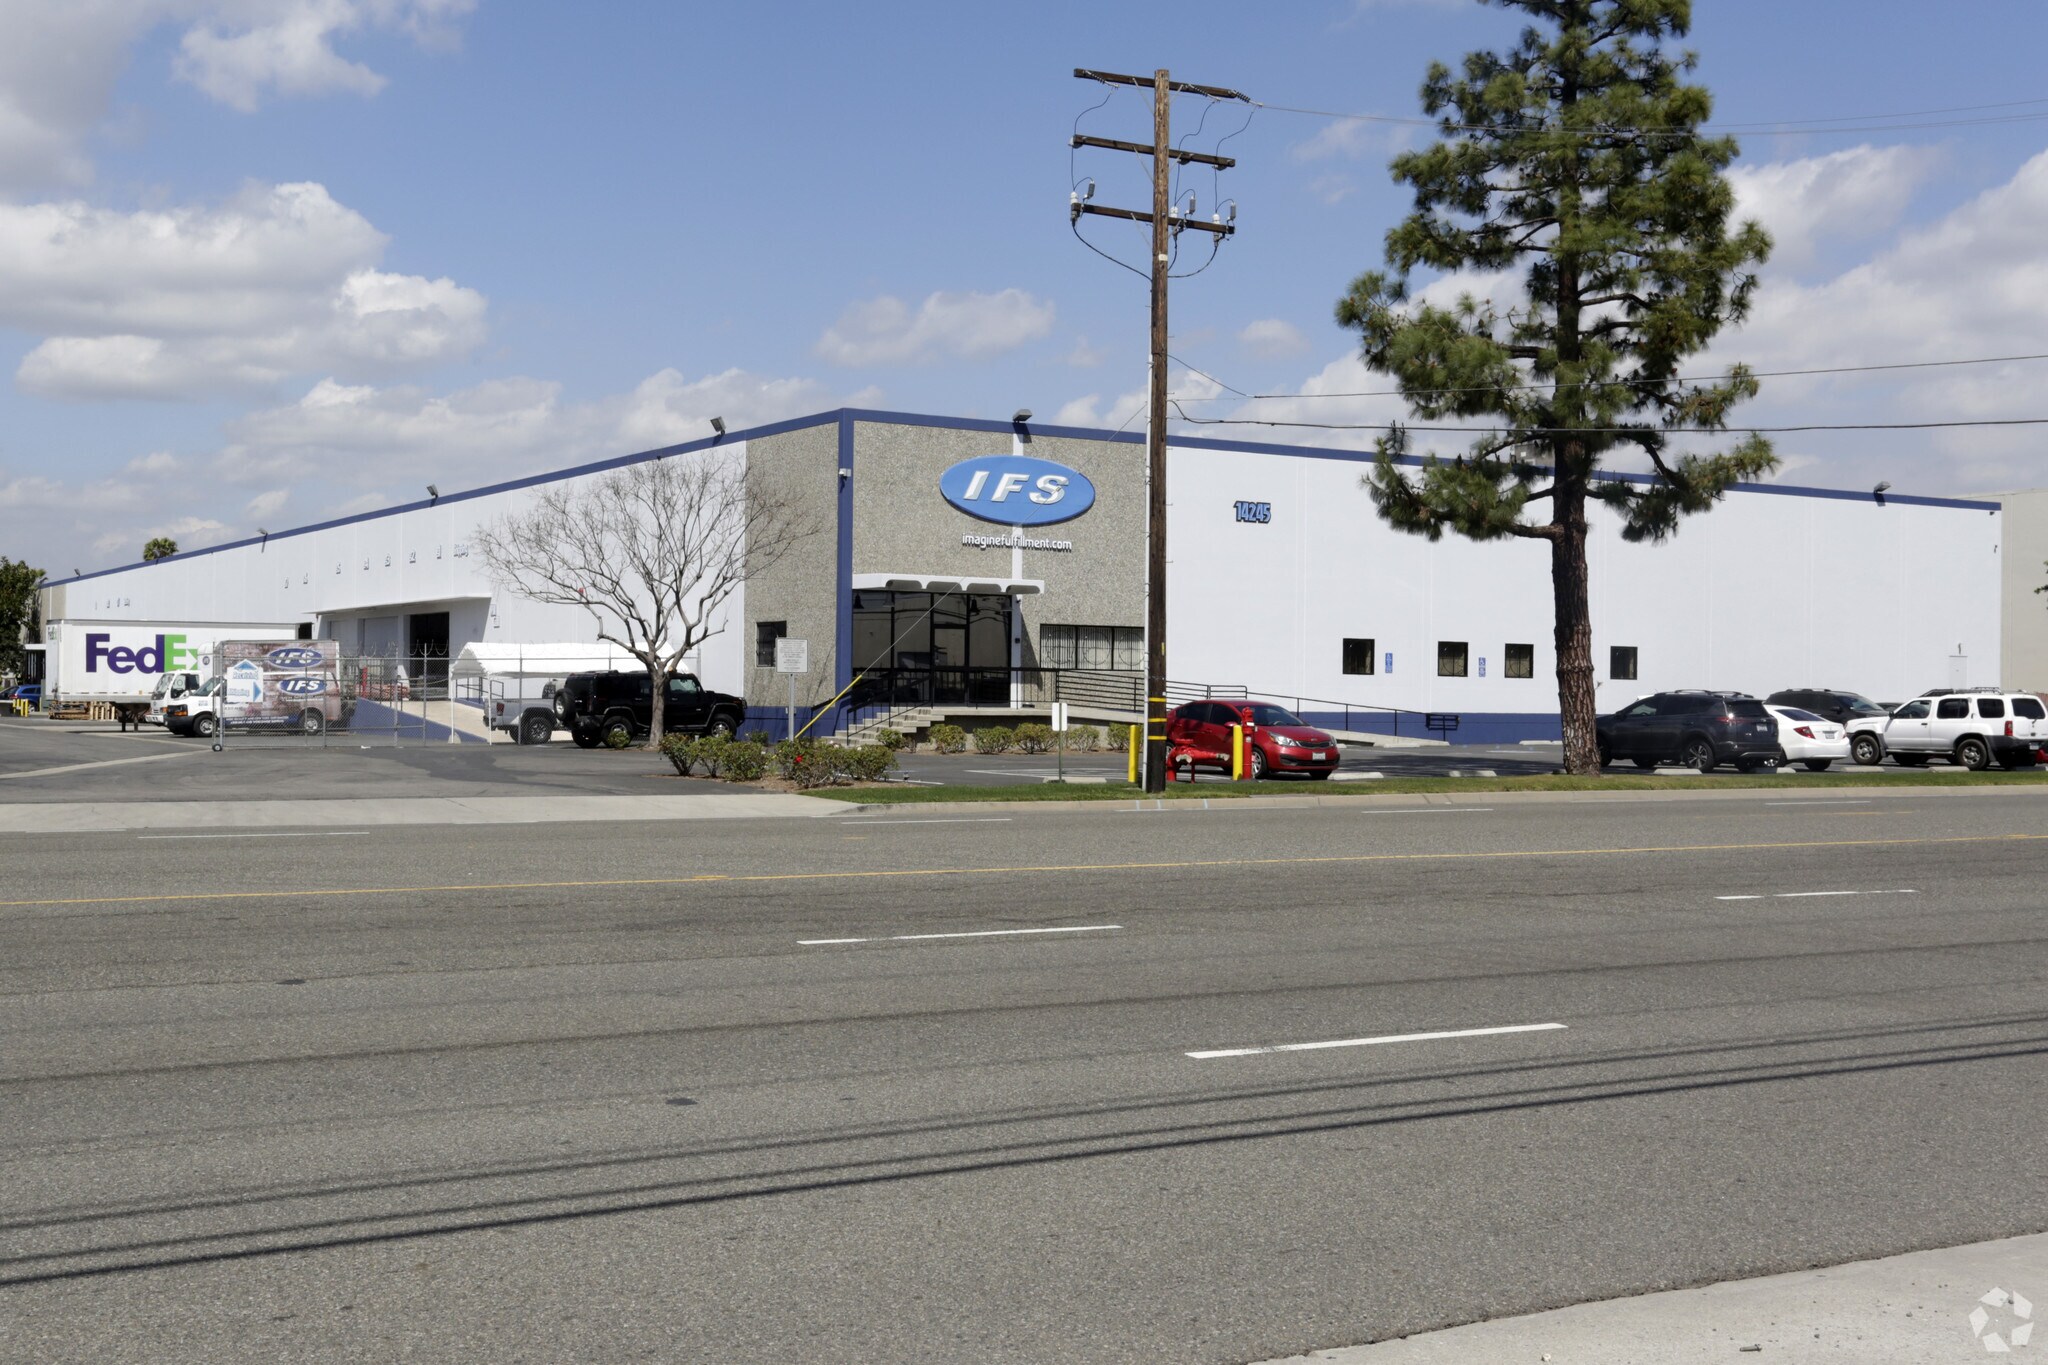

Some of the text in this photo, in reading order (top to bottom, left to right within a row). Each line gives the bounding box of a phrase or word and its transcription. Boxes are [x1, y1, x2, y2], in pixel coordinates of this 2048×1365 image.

[963, 471, 1070, 505] IFS
[1233, 500, 1272, 524] 14245
[962, 533, 1073, 551] imaginefulfillment.com
[275, 652, 315, 664] IFS
[286, 680, 320, 691] IFS
